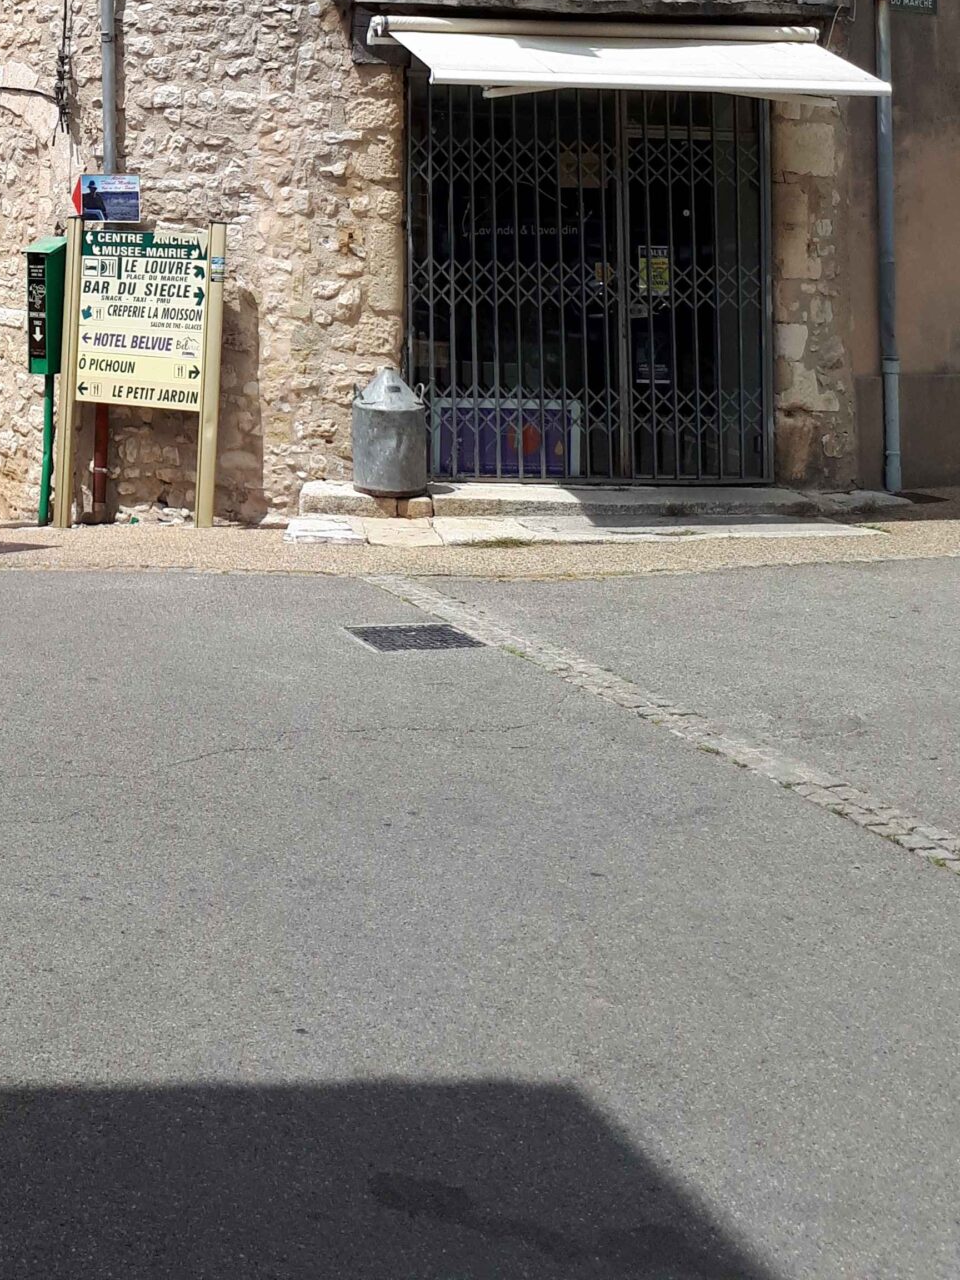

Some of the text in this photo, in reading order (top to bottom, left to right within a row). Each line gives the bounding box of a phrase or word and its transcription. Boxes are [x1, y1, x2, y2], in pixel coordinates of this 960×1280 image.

[472, 224, 579, 235] Lavnd & Lavadin
[97, 232, 198, 245] CENTRE ANCIEN
[101, 246, 189, 258] MUSEE-MAIRIE
[125, 259, 192, 275] LE LOUVRE
[83, 280, 191, 298] BAR DU SIECLE
[107, 304, 203, 322] CREPERIE LA MOISSON
[184, 323, 202, 331] GLACES
[93, 332, 173, 351] HOTEL BELVUE
[78, 354, 136, 373] Ô PICHOUN
[112, 385, 199, 404] LE PETIT JARDIN
